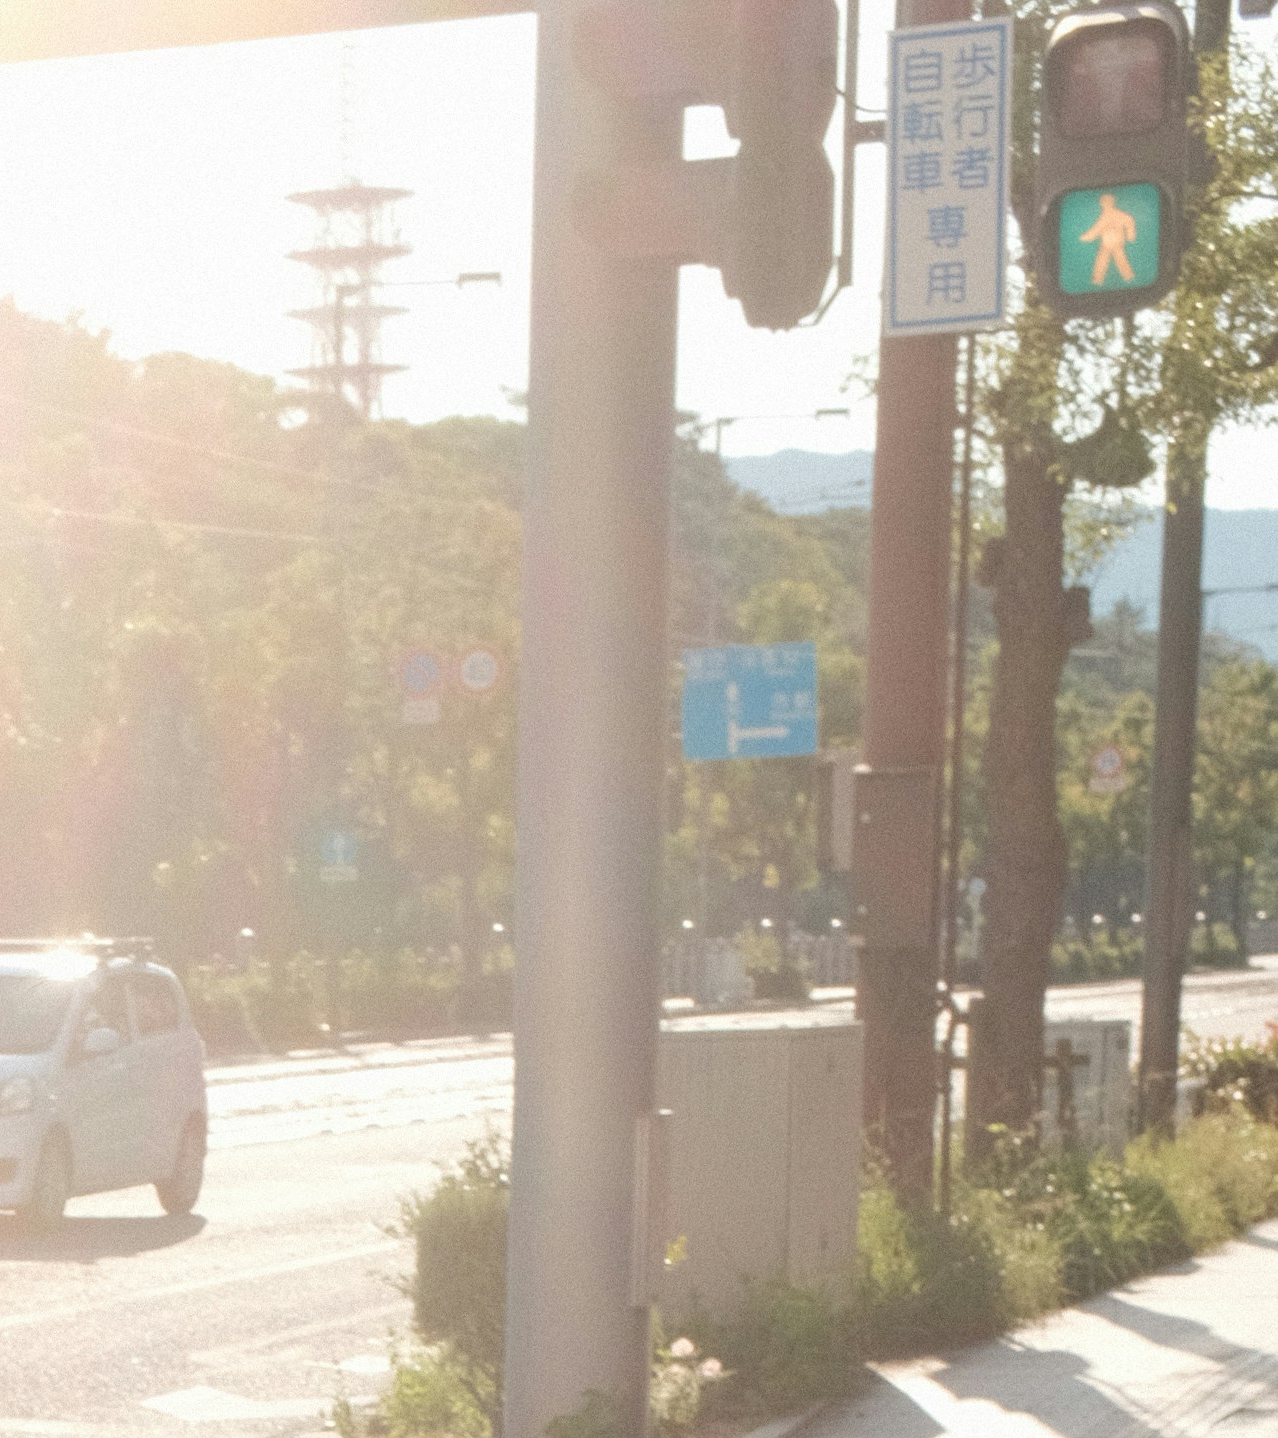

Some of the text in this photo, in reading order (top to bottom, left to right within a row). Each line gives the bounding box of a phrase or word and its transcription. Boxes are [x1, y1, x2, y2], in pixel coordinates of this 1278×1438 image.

[901, 50, 944, 192] 自転車
[952, 43, 996, 191] 歩行者
[927, 206, 968, 305] 専用
